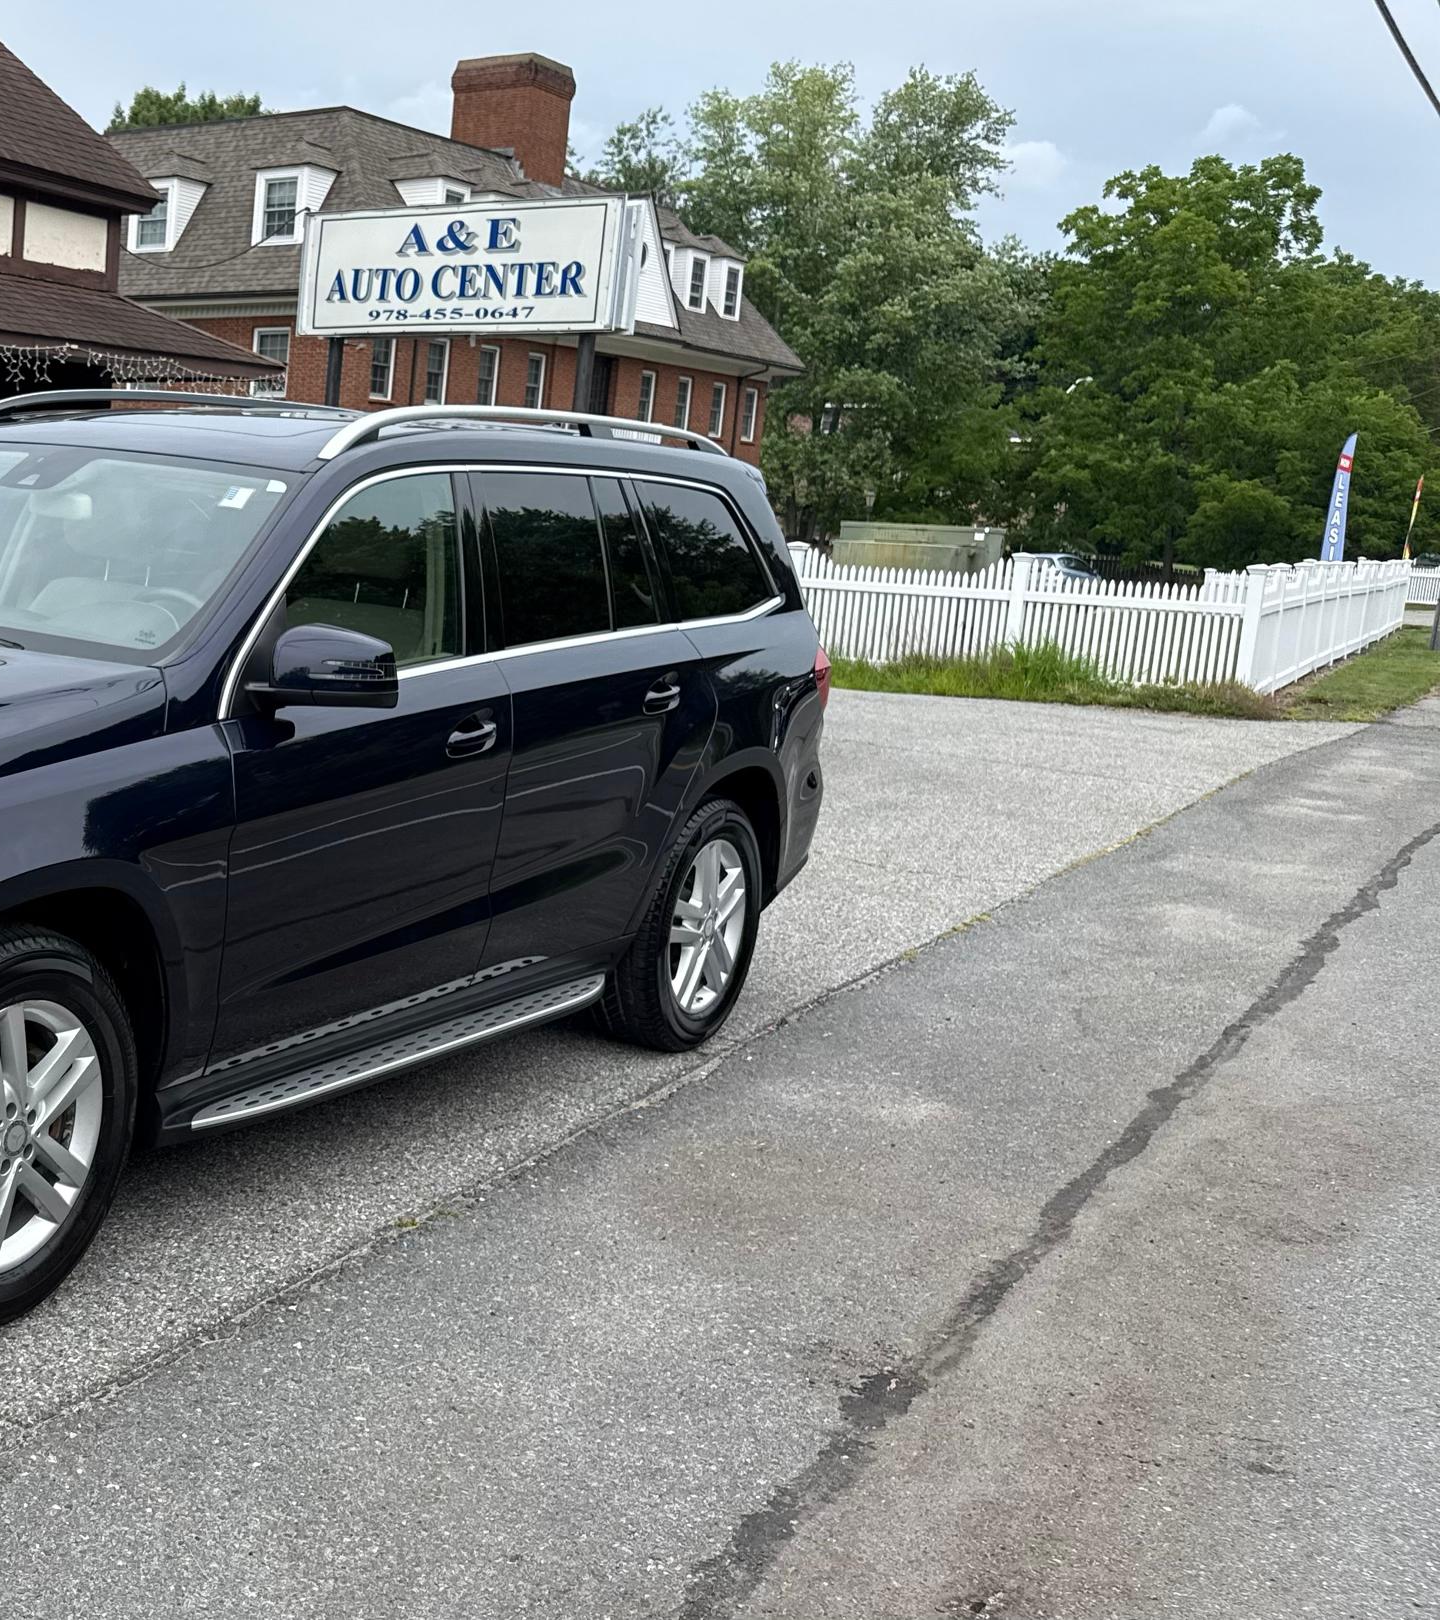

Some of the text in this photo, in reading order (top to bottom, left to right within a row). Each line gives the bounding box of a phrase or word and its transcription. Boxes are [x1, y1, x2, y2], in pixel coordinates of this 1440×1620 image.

[396, 217, 521, 257] A & E
[326, 260, 587, 303] AUTO CENTER
[367, 306, 536, 322] 978-455-0647
